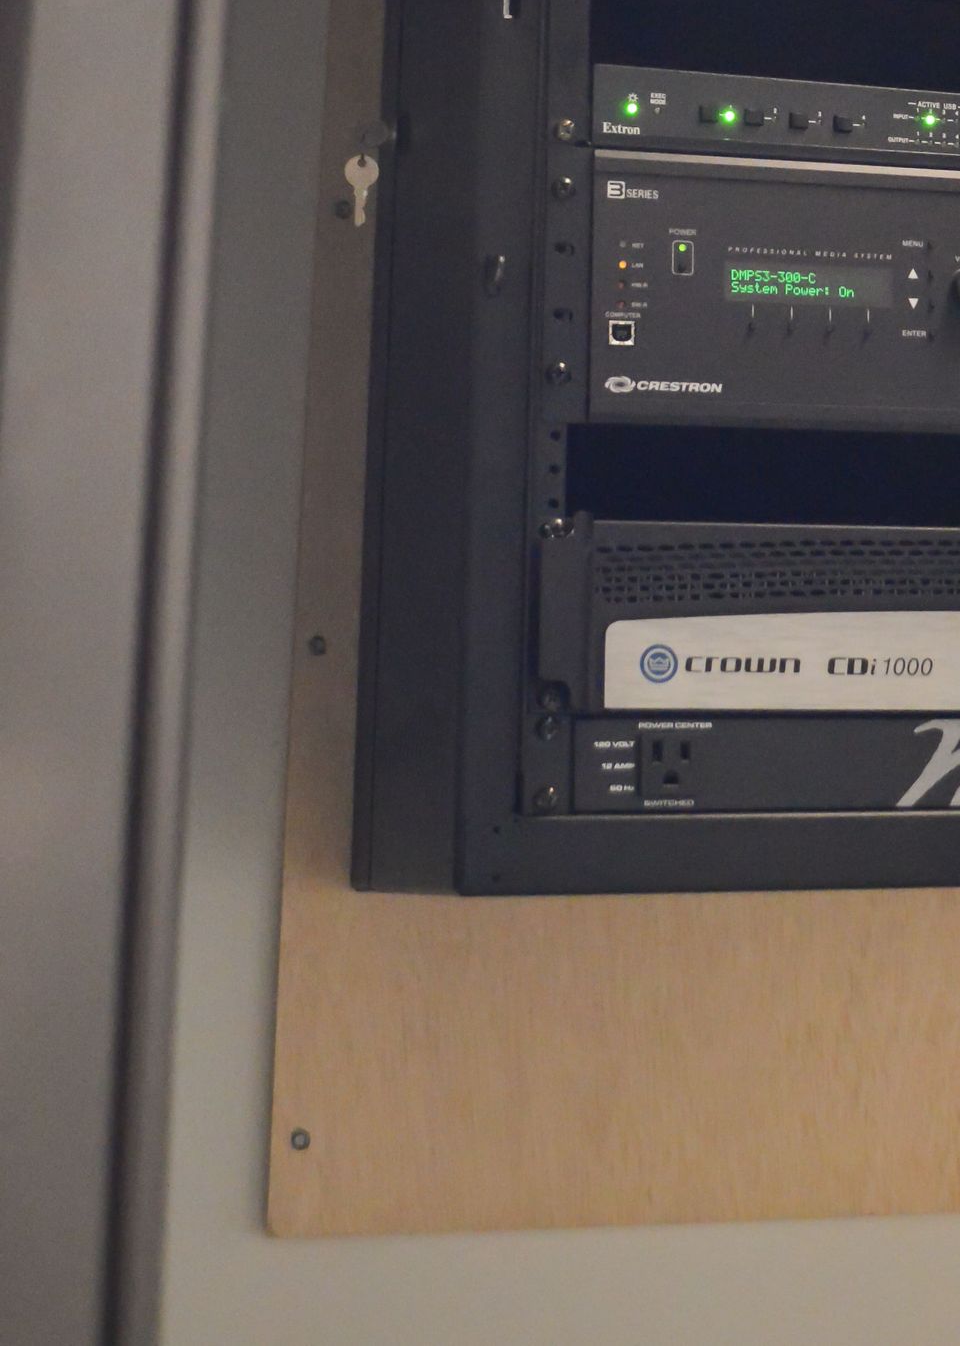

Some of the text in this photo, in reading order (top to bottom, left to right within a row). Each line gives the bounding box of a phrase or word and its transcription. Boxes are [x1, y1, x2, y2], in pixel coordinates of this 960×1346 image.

[917, 100, 940, 109] ACTIVE
[602, 121, 641, 135] Extron
[626, 189, 659, 200] SERIES
[669, 228, 697, 236] POWER
[902, 240, 924, 248] MENU
[727, 246, 808, 257] PROFESSIONAL
[730, 269, 817, 284] DMPS3-300-C
[730, 281, 855, 298] System Power: On
[902, 330, 927, 338] ENTER
[636, 380, 723, 393] CRESTRON
